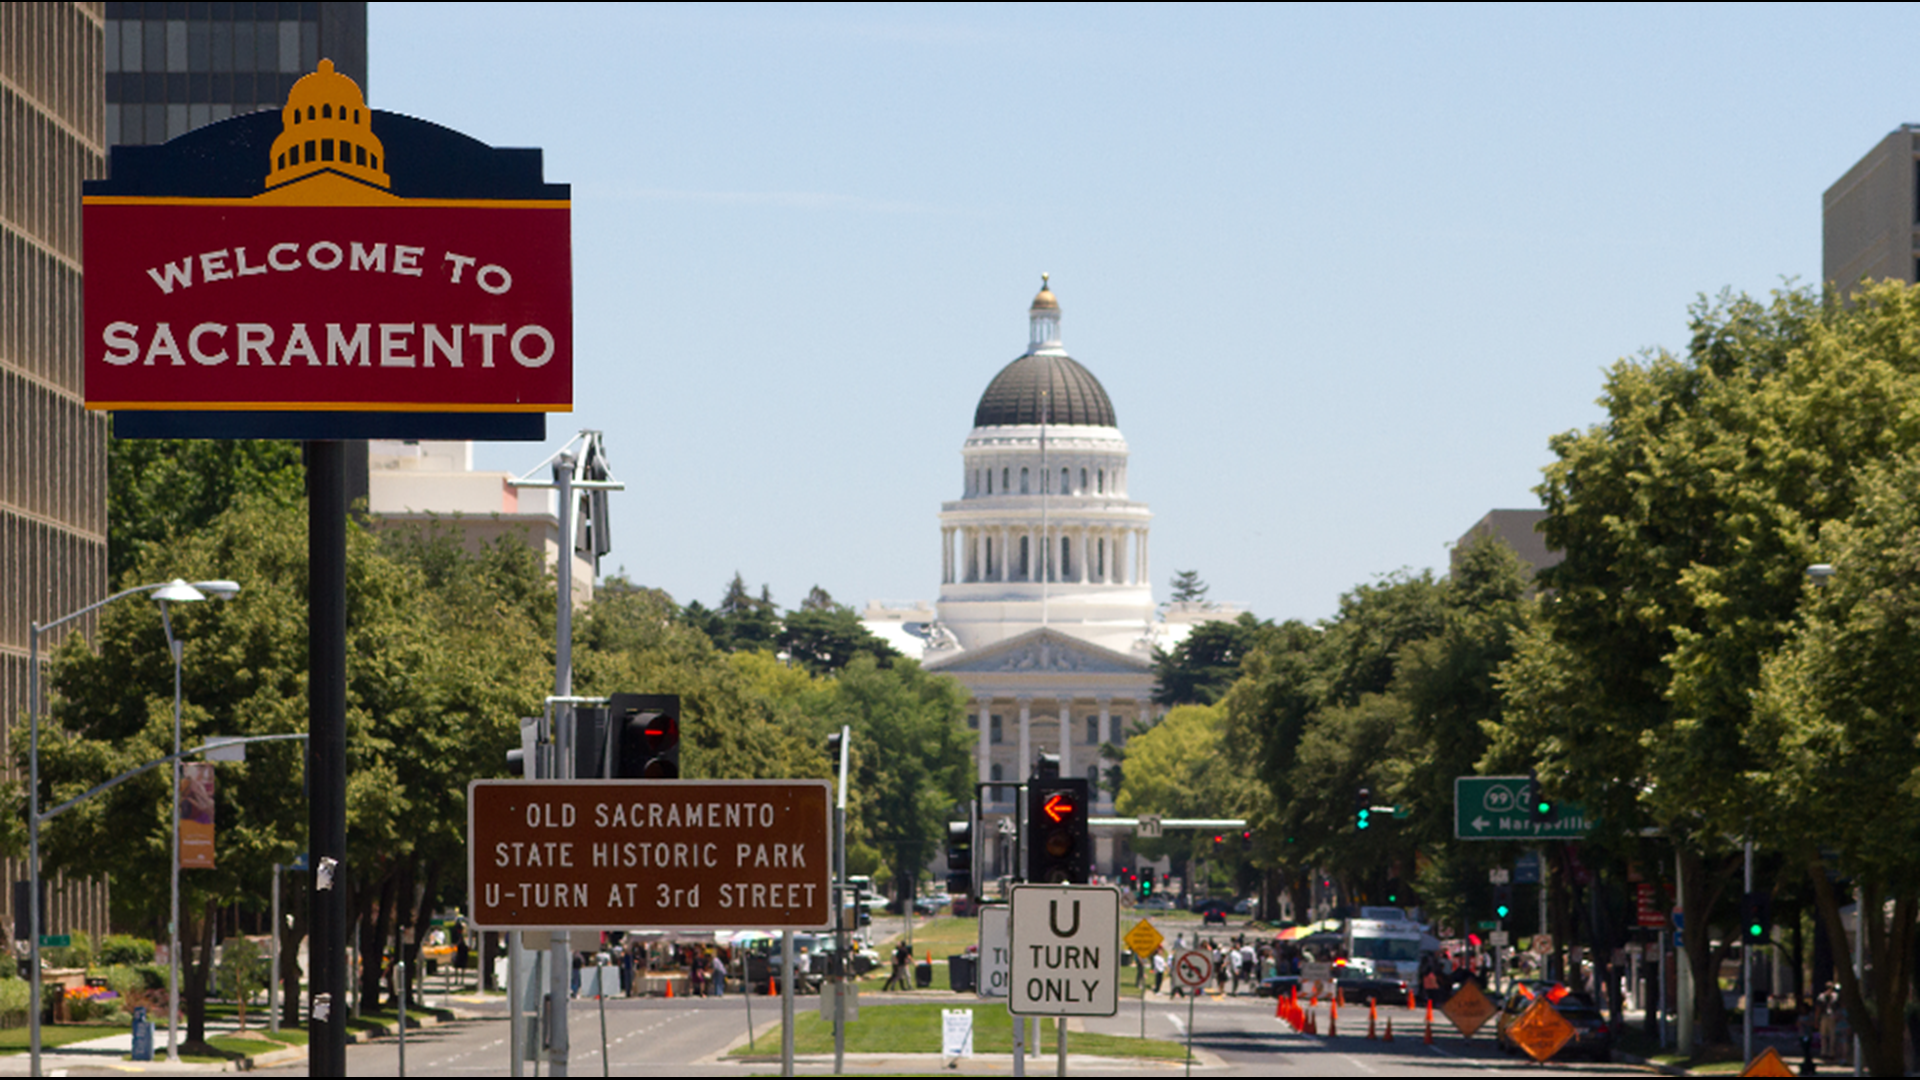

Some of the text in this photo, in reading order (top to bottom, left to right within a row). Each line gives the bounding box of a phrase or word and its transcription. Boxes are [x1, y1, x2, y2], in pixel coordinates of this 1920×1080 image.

[146, 240, 513, 295] WELCOME TO
[102, 321, 555, 368] SACRAMENTO
[1490, 792, 1508, 805] 99
[526, 803, 774, 828] OLD SACRAMENTO
[1499, 816, 1593, 834] Marysville
[495, 843, 806, 868] STATE HISTORIC PARK
[485, 883, 817, 908] U-TURN AT 3rd STREET
[1050, 900, 1080, 938] U
[1029, 945, 1099, 969] TURN
[1027, 978, 1099, 1002] ONLY
